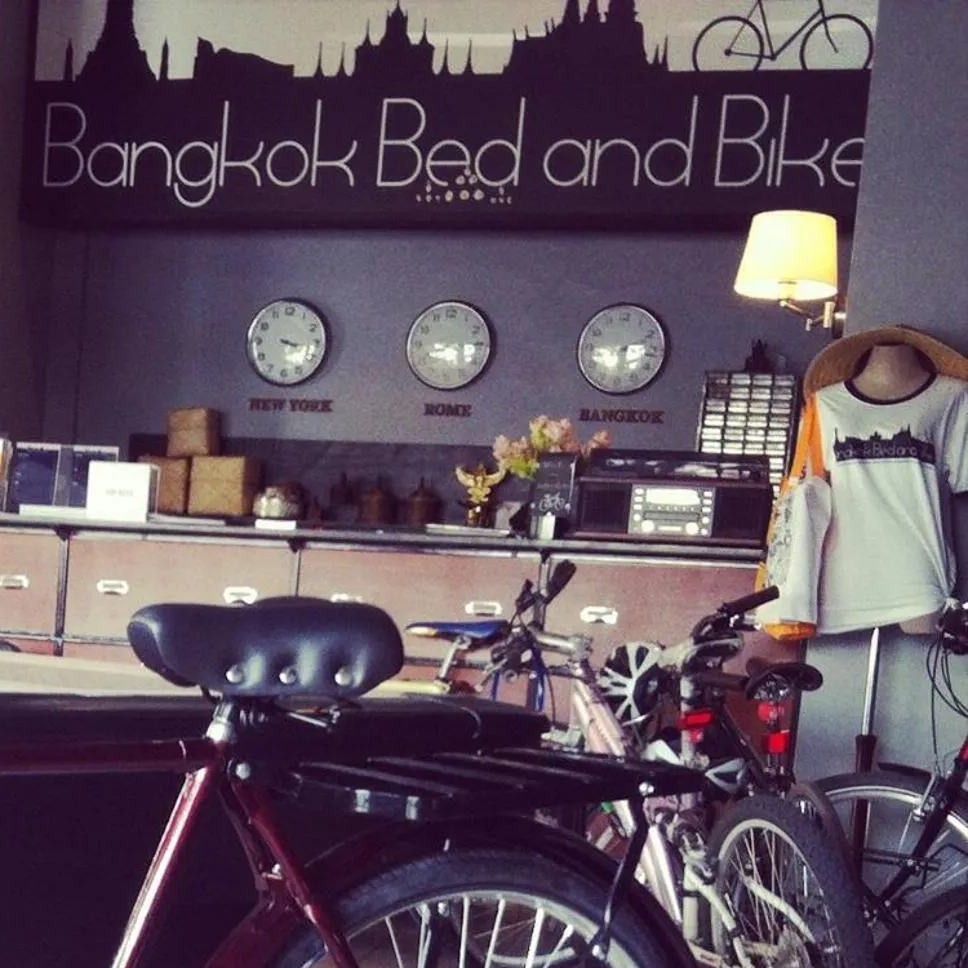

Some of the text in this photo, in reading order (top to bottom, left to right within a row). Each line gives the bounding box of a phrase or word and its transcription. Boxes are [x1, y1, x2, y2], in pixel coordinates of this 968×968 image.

[43, 93, 866, 208] Bangkok Bed and Bike
[249, 398, 333, 413] NEW YORK
[424, 403, 472, 417] ROME
[579, 408, 665, 424] BANGKOK
